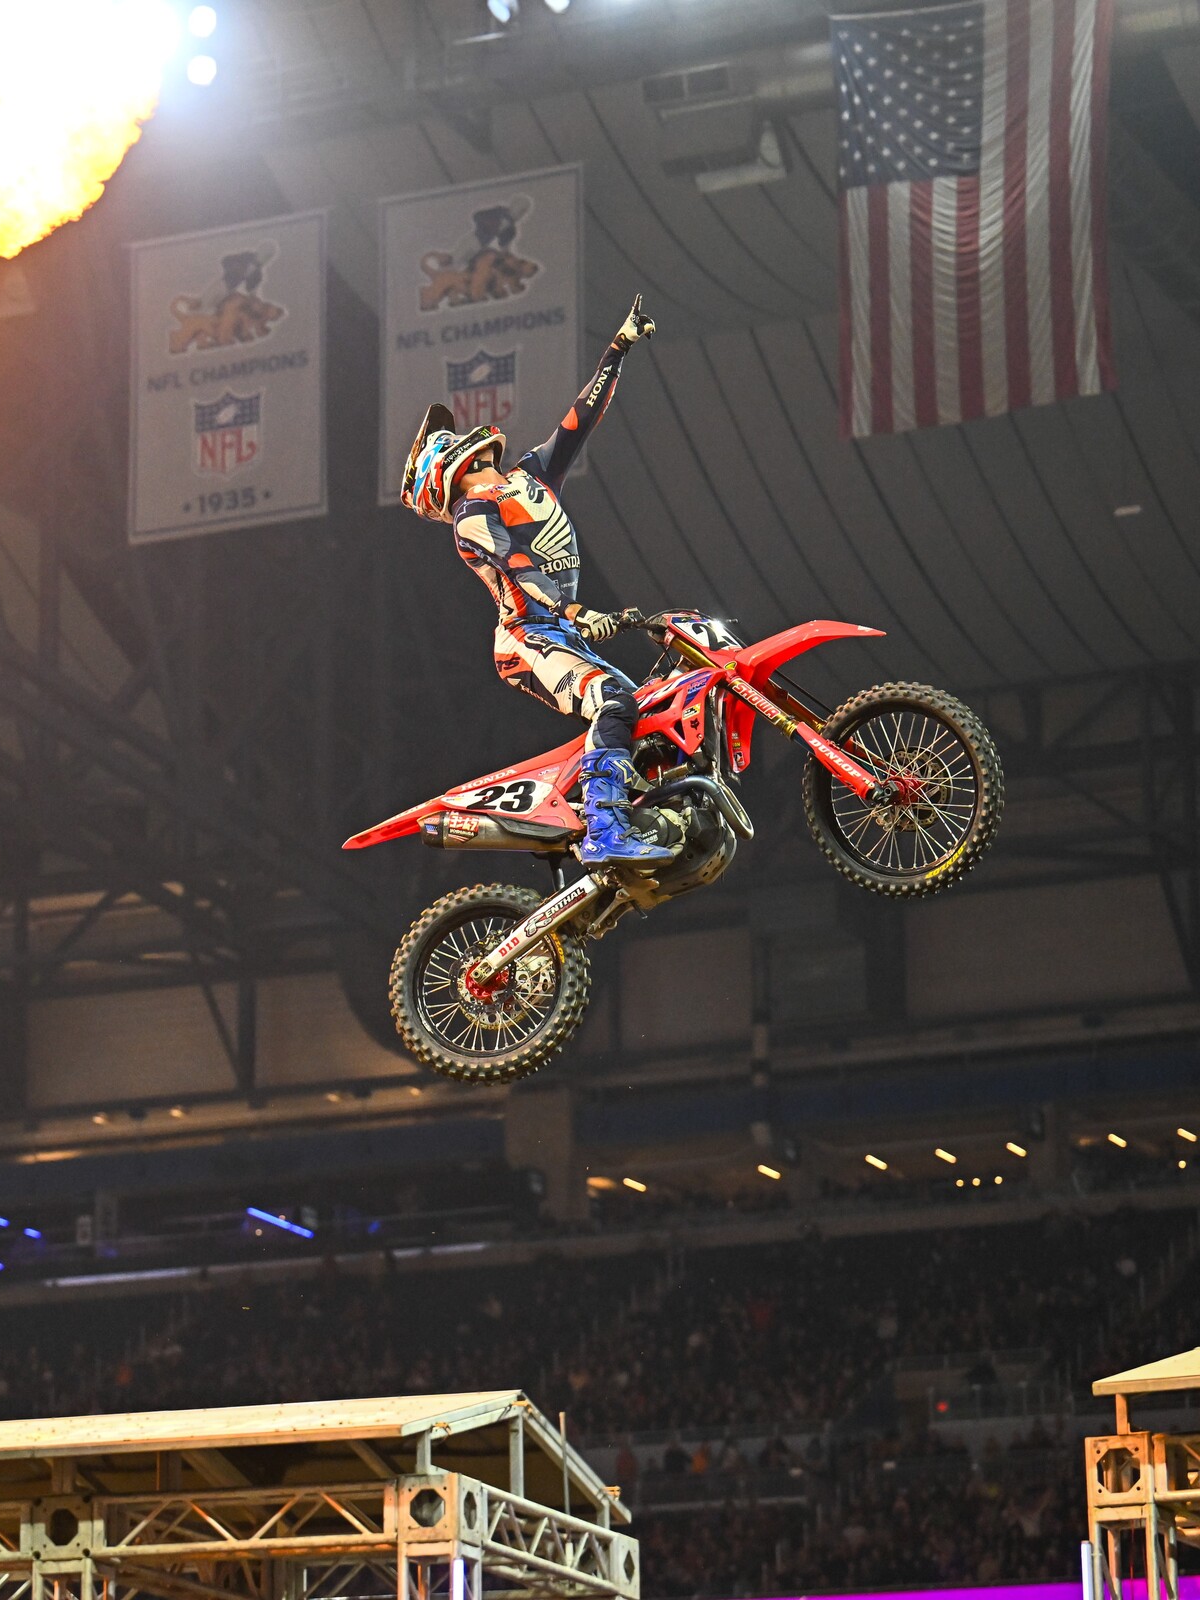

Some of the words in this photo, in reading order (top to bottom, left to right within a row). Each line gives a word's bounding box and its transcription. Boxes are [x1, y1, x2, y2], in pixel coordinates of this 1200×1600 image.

[397, 328, 435, 348] NFL
[440, 306, 566, 344] CHAMPIONS
[148, 371, 183, 392] NFL
[190, 350, 309, 386] CHAMPIONS
[453, 384, 513, 427] NFL
[200, 427, 258, 475] NFL
[199, 487, 257, 514] 1935
[497, 488, 522, 503] SHOWA
[540, 555, 580, 576] HONDA
[731, 682, 782, 720] SHOWA
[808, 738, 862, 778] DUNLOP
[460, 768, 518, 791] HONDA
[466, 780, 537, 812] 23
[524, 887, 586, 938] RENTHAL
[498, 936, 520, 957] DID
